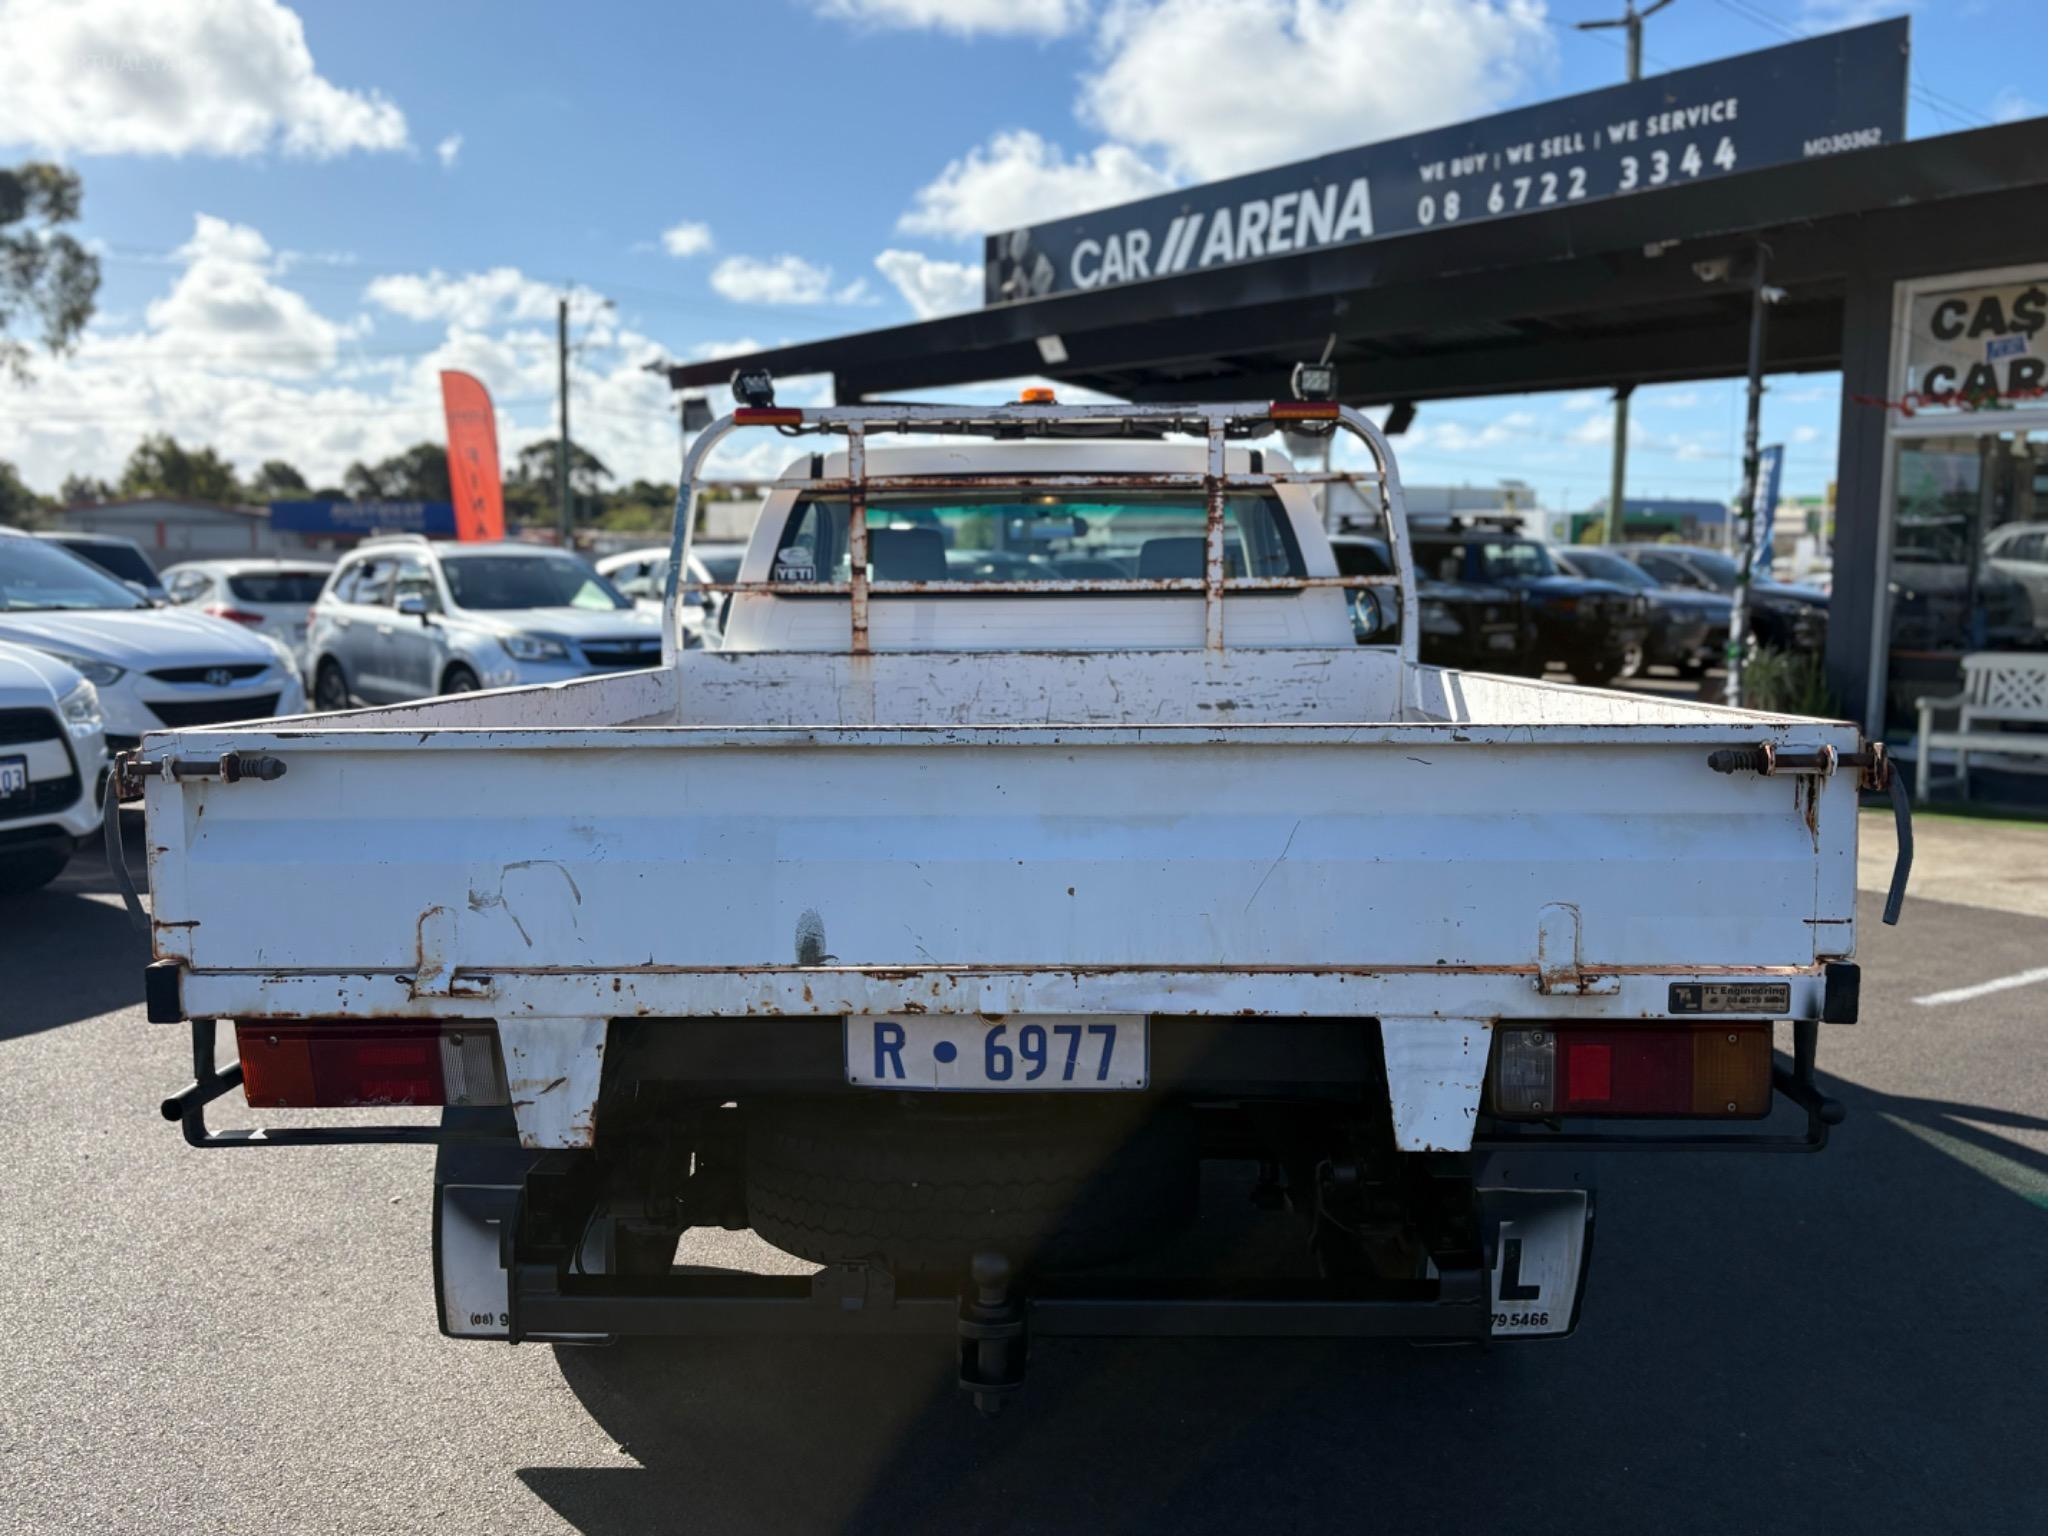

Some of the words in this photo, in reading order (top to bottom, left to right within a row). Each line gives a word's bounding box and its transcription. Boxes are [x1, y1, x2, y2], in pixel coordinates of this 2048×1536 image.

[1419, 163, 1446, 183] WE
[1450, 152, 1488, 178] BUY
[1506, 142, 1535, 165] WE
[1540, 132, 1585, 160] SELL
[1607, 122, 1639, 145] WE
[1645, 98, 1739, 138] SERVICE
[1417, 190, 1461, 226] 08
[1486, 166, 1587, 215] 6722
[1618, 135, 1738, 191] 3344
[1069, 227, 1153, 290] CAR
[1198, 176, 1375, 267] ARENA
[778, 567, 812, 580] YETI
[1704, 987, 1717, 995] TL
[1720, 986, 1786, 997] Engineering
[873, 1021, 906, 1080] R
[984, 1023, 1118, 1081] 6977
[1499, 1239, 1540, 1301] L
[470, 1312, 494, 1326] (08)
[1510, 1312, 1549, 1327] 5466
